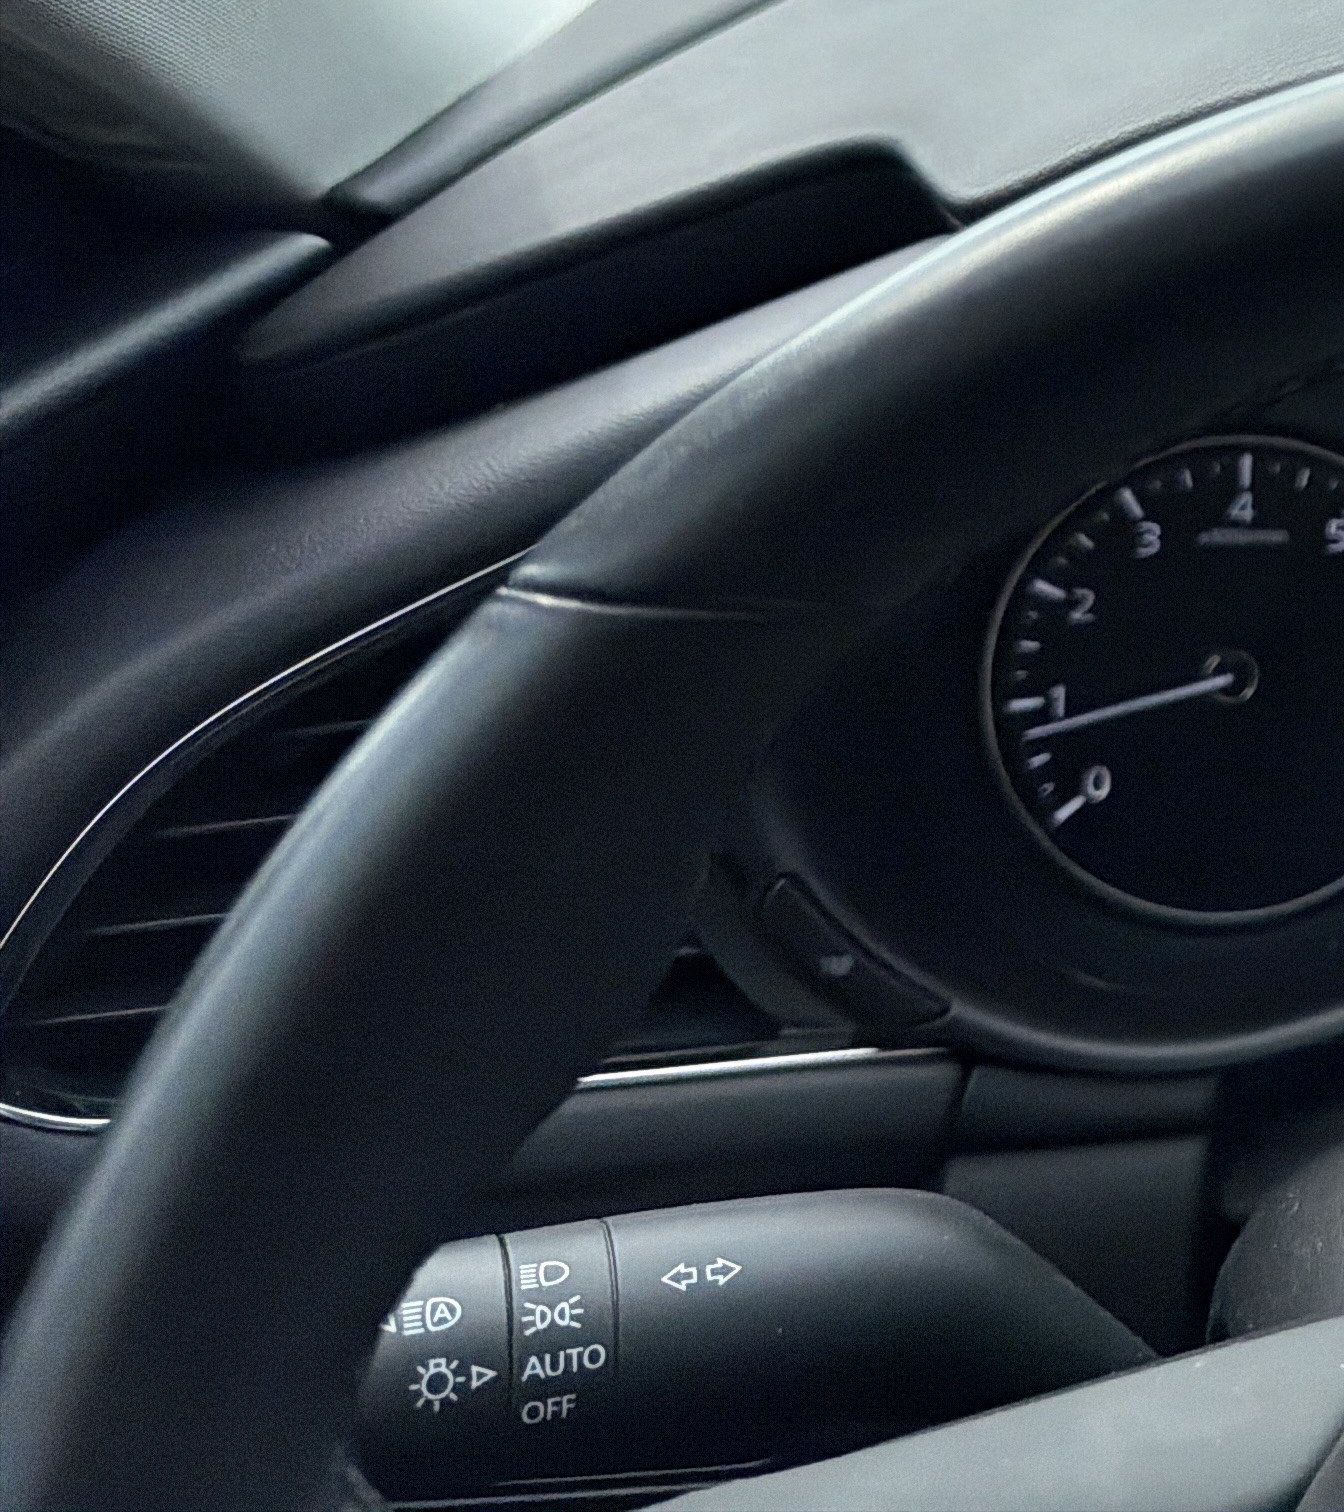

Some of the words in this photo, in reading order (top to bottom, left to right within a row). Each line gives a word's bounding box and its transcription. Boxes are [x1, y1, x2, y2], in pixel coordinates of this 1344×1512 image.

[1229, 491, 1254, 522] 4
[1132, 521, 1161, 558] 3
[1068, 588, 1096, 624] 2
[1046, 684, 1067, 719] 1
[1083, 764, 1112, 802] 0
[521, 1343, 606, 1382] AUTO
[521, 1394, 577, 1425] OFF
